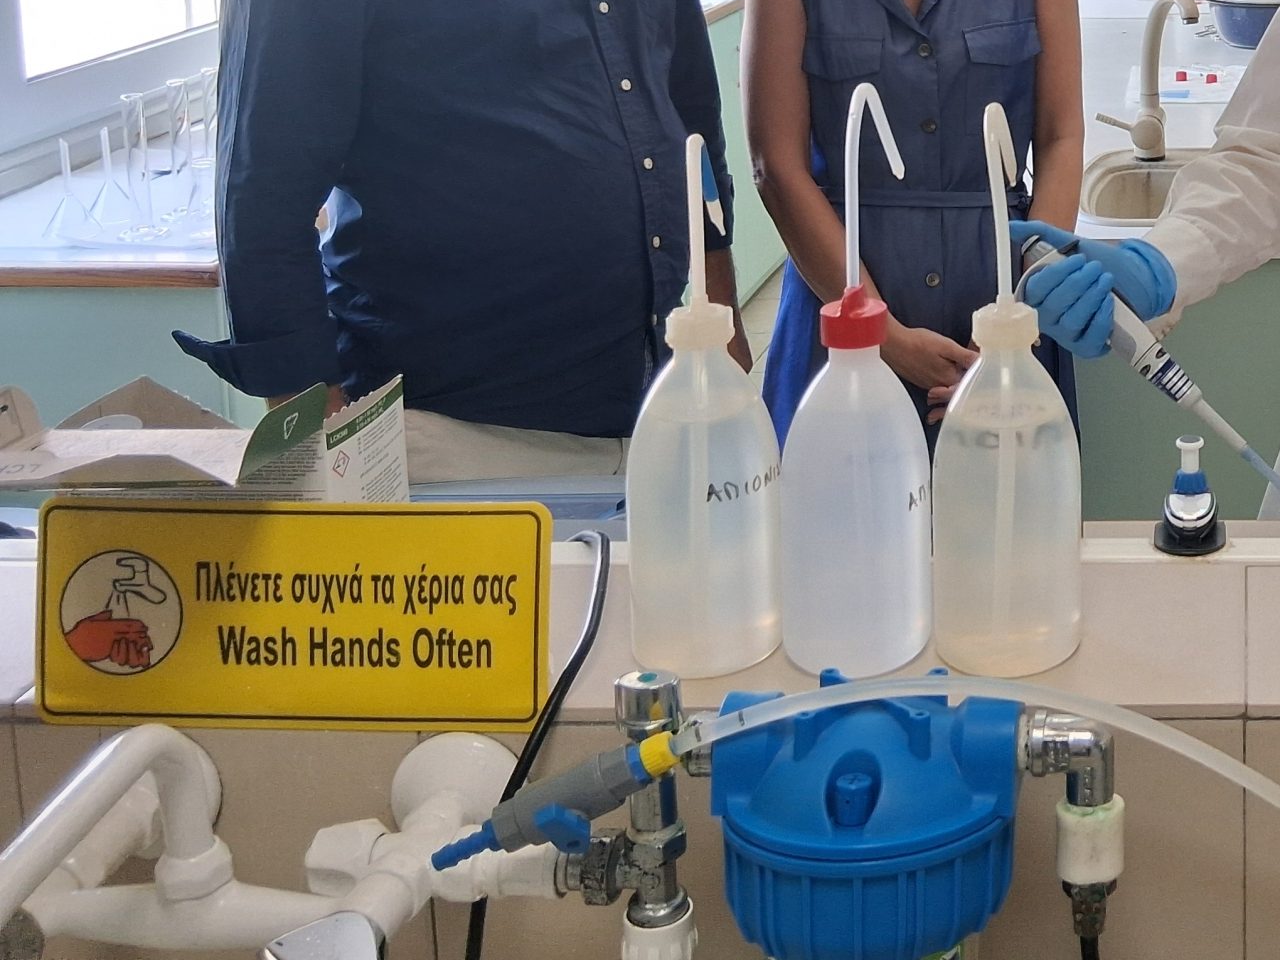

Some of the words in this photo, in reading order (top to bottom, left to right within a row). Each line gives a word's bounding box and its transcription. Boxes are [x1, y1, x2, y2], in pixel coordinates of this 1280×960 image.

[195, 561, 284, 604] Πλένετε
[290, 564, 363, 614] συχνά
[371, 574, 395, 604] τα
[402, 564, 465, 615] χέρια
[473, 574, 518, 616] σας
[217, 625, 297, 668] Wash
[309, 626, 401, 669] Hands
[412, 627, 492, 669] Often
